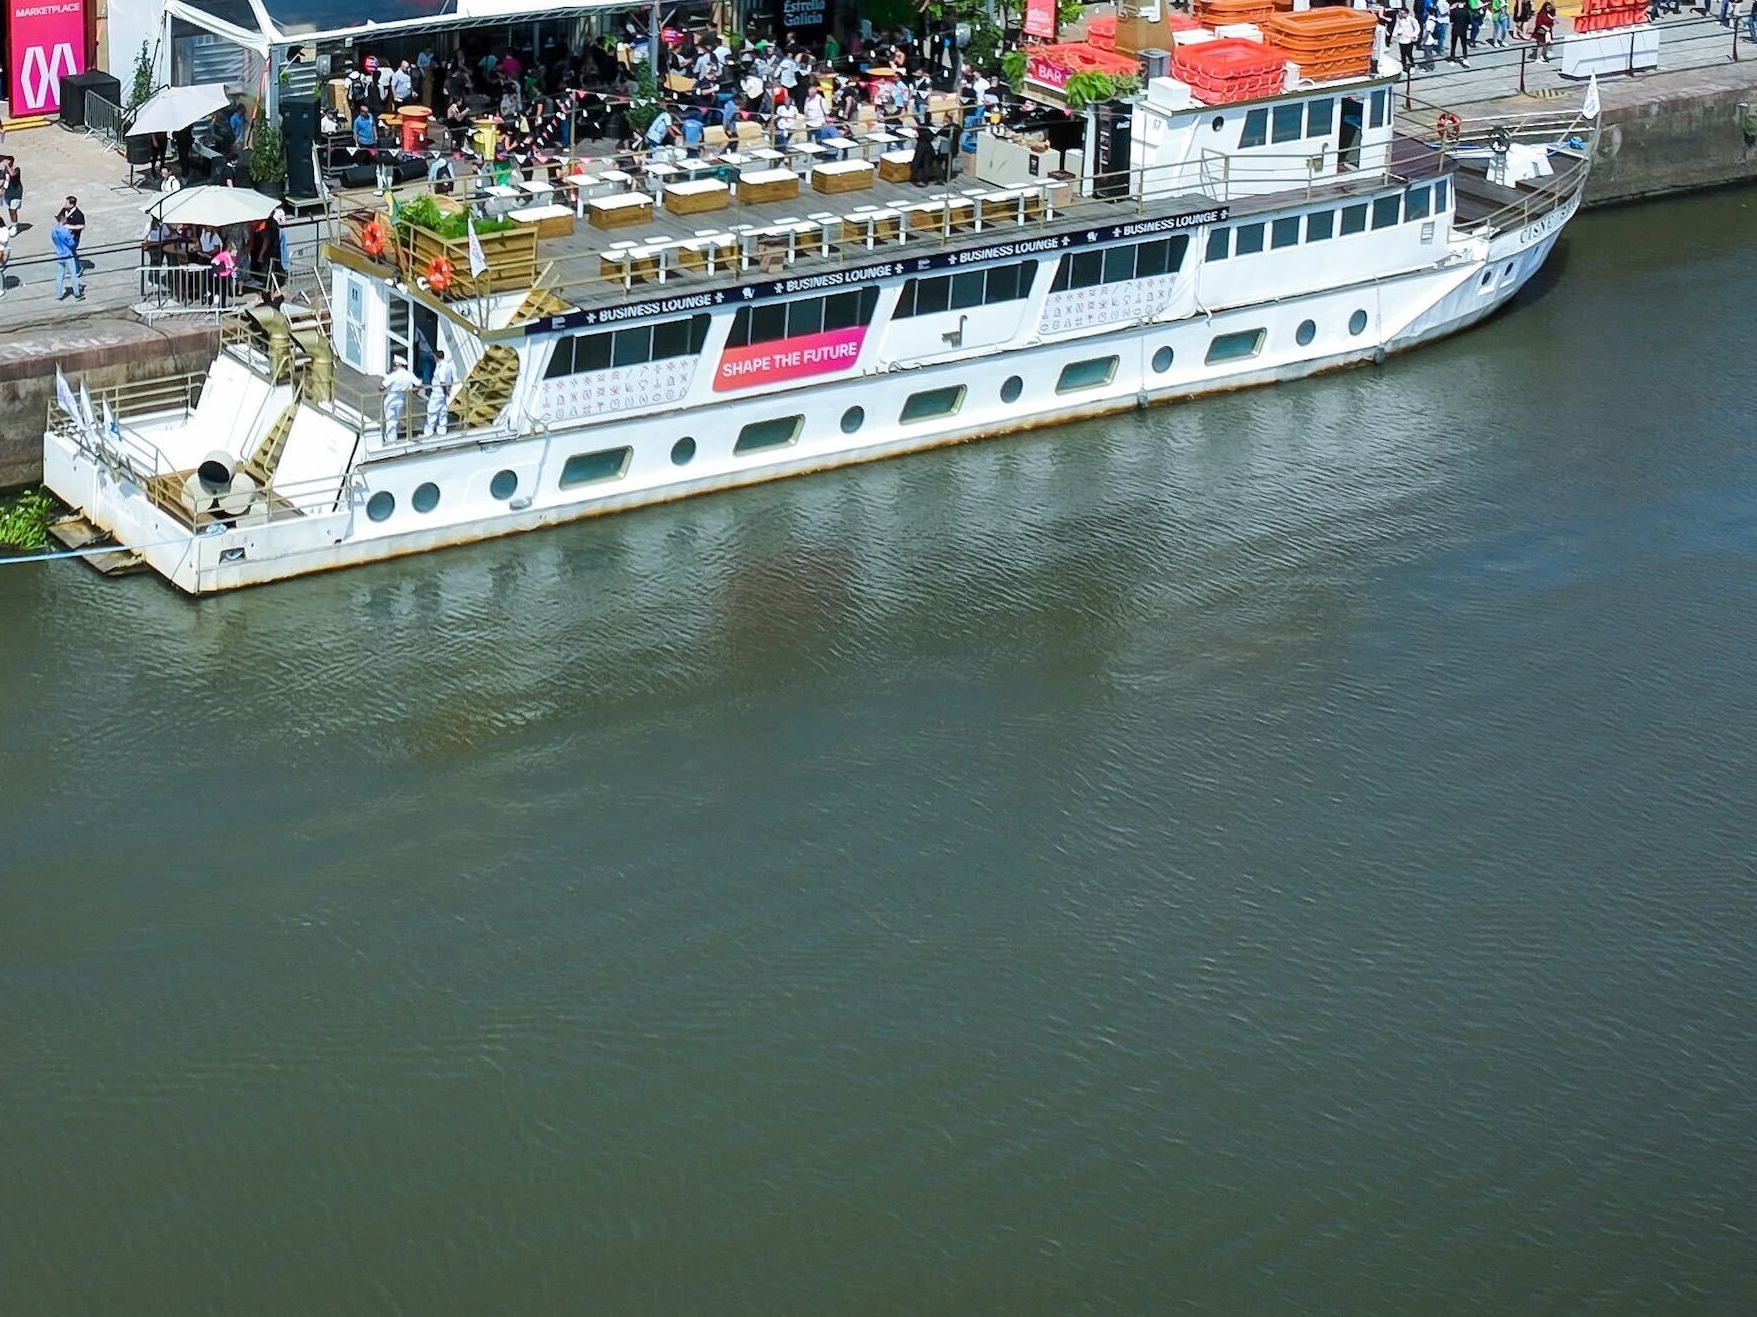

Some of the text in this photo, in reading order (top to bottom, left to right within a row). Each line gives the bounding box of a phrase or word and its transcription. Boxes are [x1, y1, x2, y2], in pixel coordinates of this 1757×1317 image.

[15, 3, 80, 18] MARKETPLACE
[784, 12, 823, 26] Galicia
[1039, 64, 1062, 84] BAR
[1124, 211, 1219, 236] BUSINESS LOUNGE
[959, 238, 1059, 264] BUSINESS LOUNGE
[786, 265, 892, 293] BUSINESS LOUNGE
[599, 294, 712, 322] BUSINESS LOUNGE
[722, 342, 858, 377] SHAPE THE FUTURE
